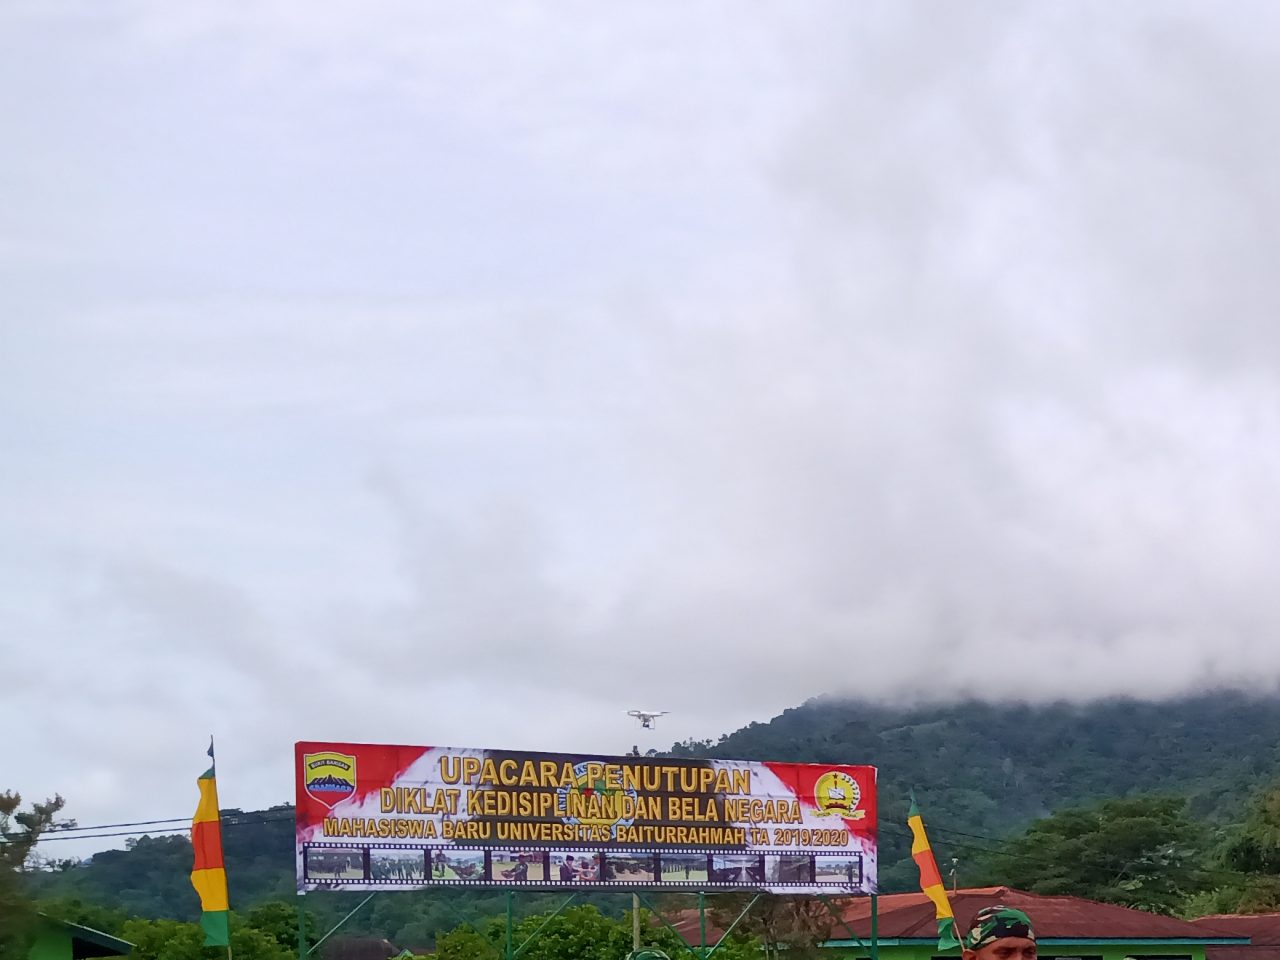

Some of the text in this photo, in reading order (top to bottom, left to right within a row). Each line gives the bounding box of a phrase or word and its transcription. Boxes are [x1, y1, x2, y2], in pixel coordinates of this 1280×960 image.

[440, 756, 578, 788] UPACARA
[586, 763, 751, 794] PENUTUPAN
[380, 787, 803, 824] DIKLAT KEDISIPLINAN DAN BELA NEGARA
[323, 818, 848, 846] MAHASISWA BARU UNIVERSITAS BAITURRAHMAH TA 2019/2020
